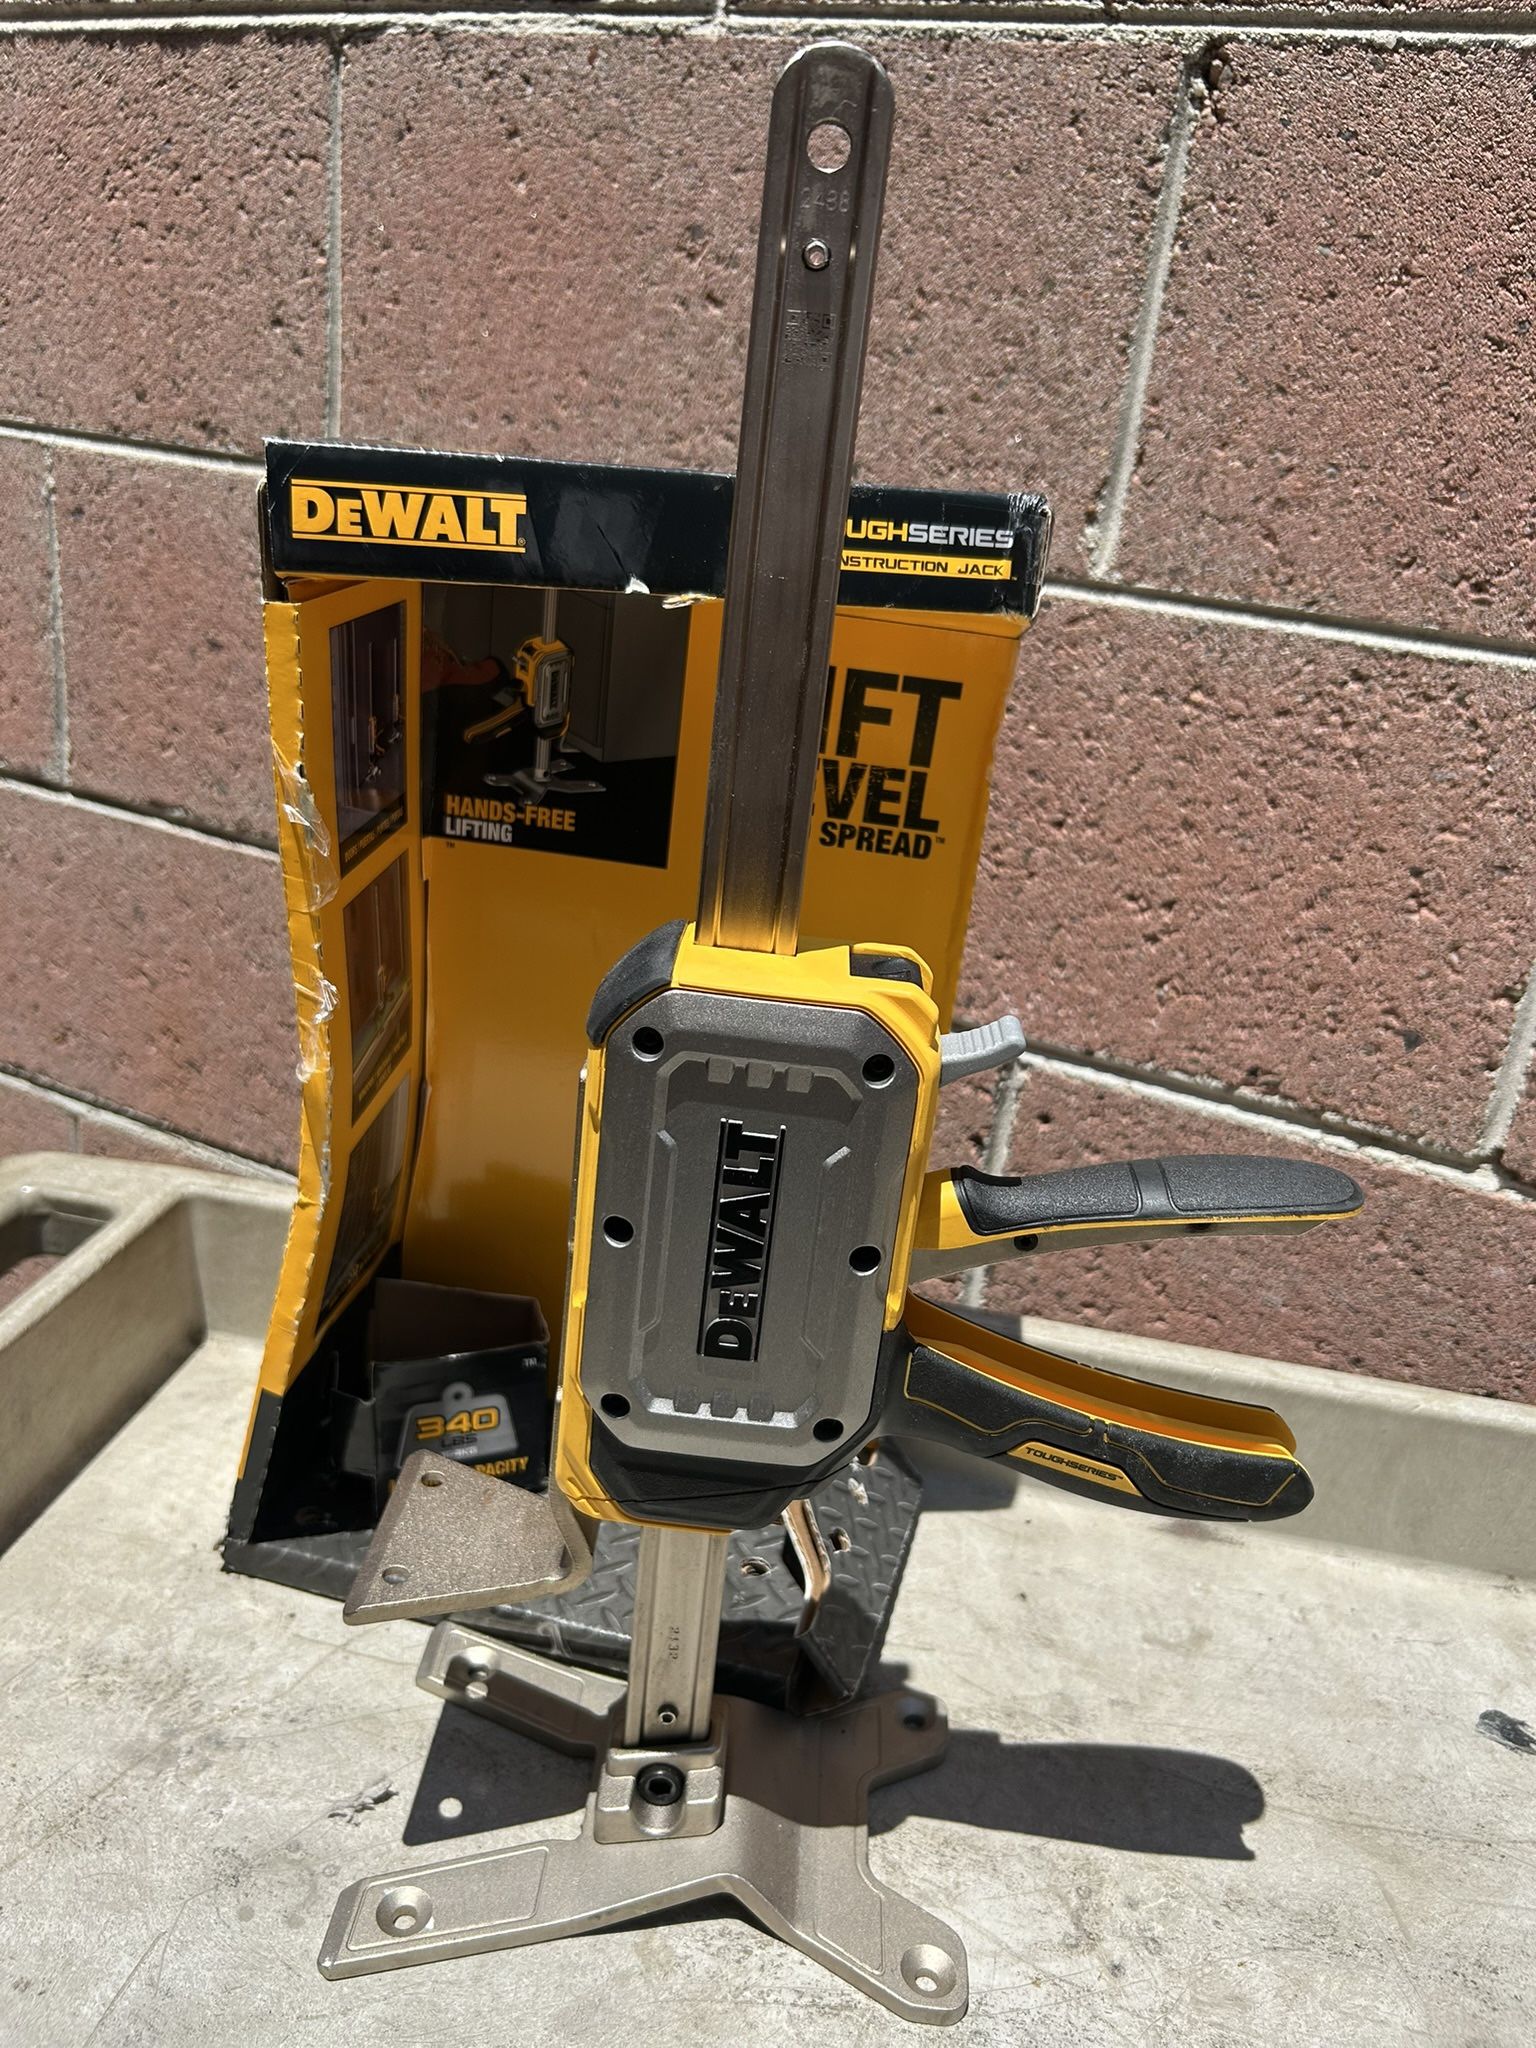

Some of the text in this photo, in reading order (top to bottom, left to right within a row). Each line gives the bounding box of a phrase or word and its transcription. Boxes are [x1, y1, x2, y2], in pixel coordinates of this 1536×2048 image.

[844, 518, 1014, 549] UGHSERIES
[841, 554, 1004, 577] NSTRUCTION JACK
[820, 758, 940, 833] VEL
[445, 816, 513, 842] LIFTING
[446, 794, 577, 832] HANDS-FREE
[702, 1119, 779, 1362] DEWALT
[415, 1406, 501, 1441] 340
[441, 1432, 479, 1448] LBS
[474, 1455, 530, 1477] PACITY
[1025, 1446, 1117, 1481] TOUGHSERIES
